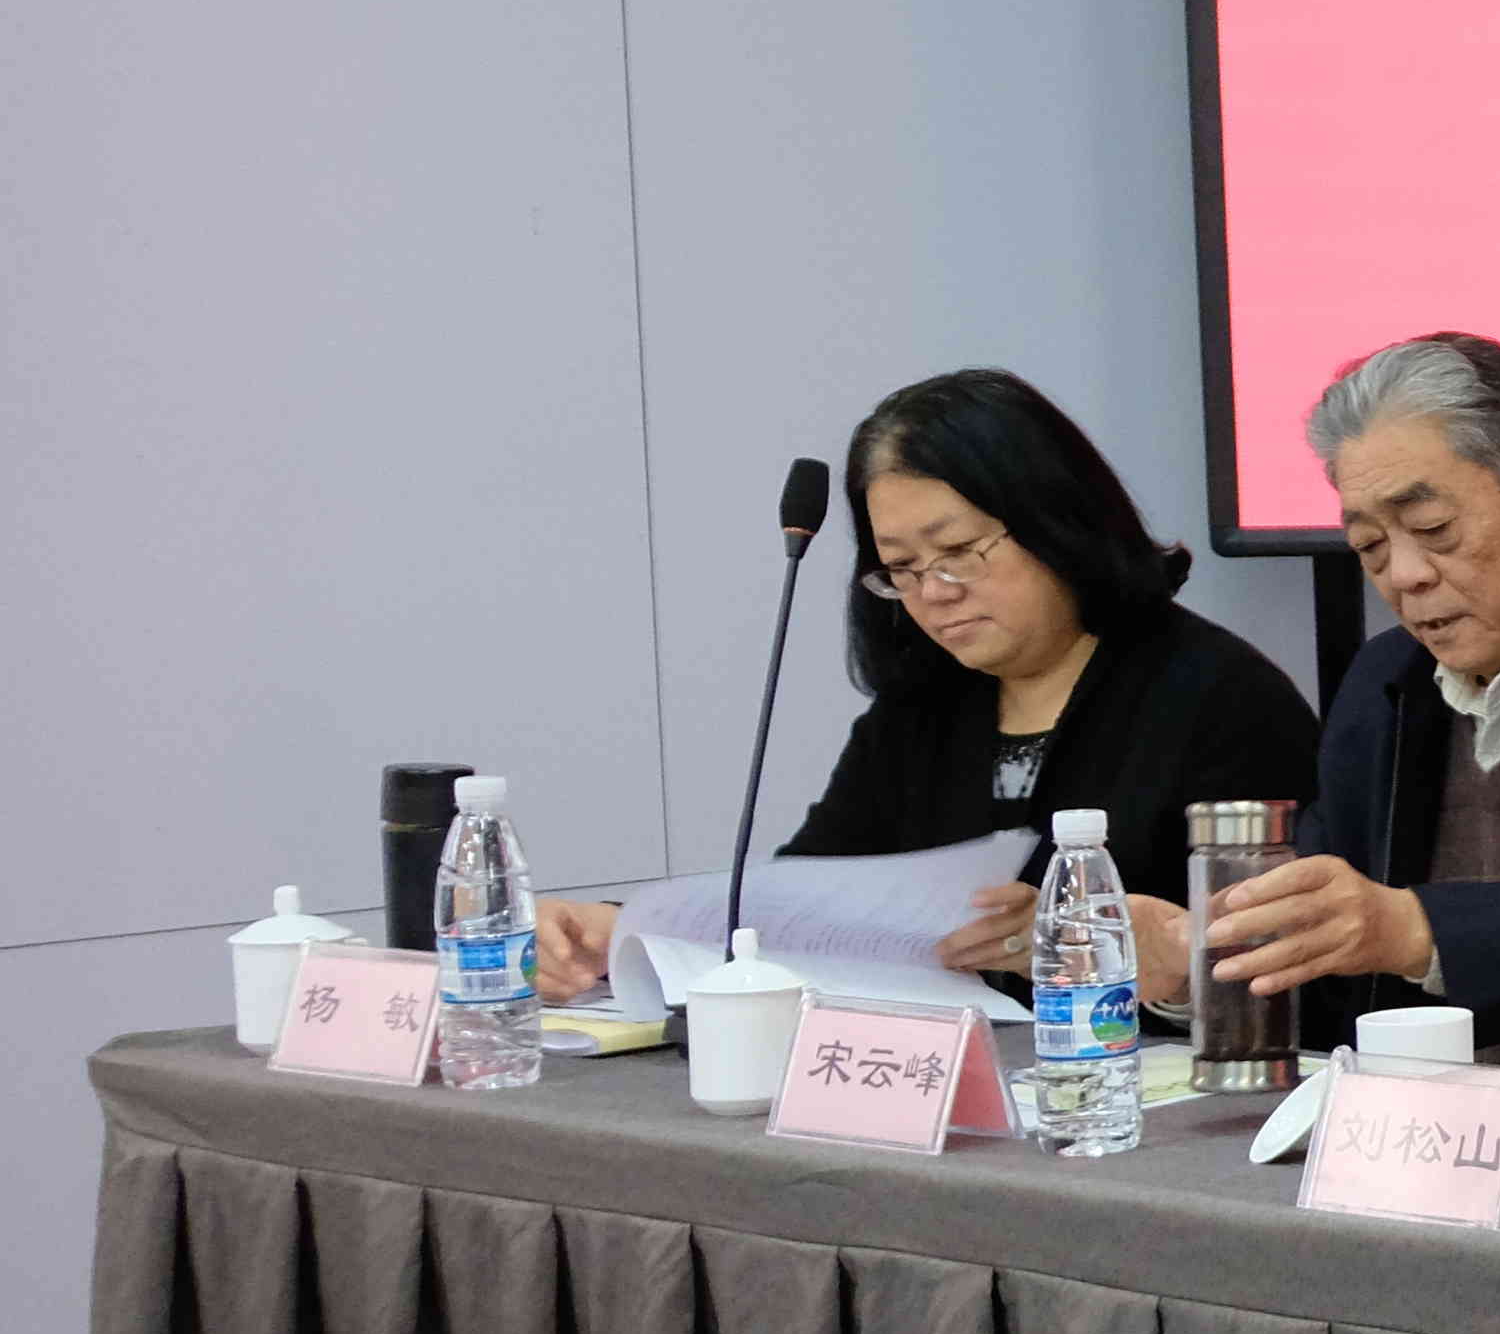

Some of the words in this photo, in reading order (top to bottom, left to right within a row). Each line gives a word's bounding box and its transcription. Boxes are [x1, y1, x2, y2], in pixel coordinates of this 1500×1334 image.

[807, 1039, 947, 1097] 宋云峰
[1336, 1111, 1500, 1173] 刘松山
